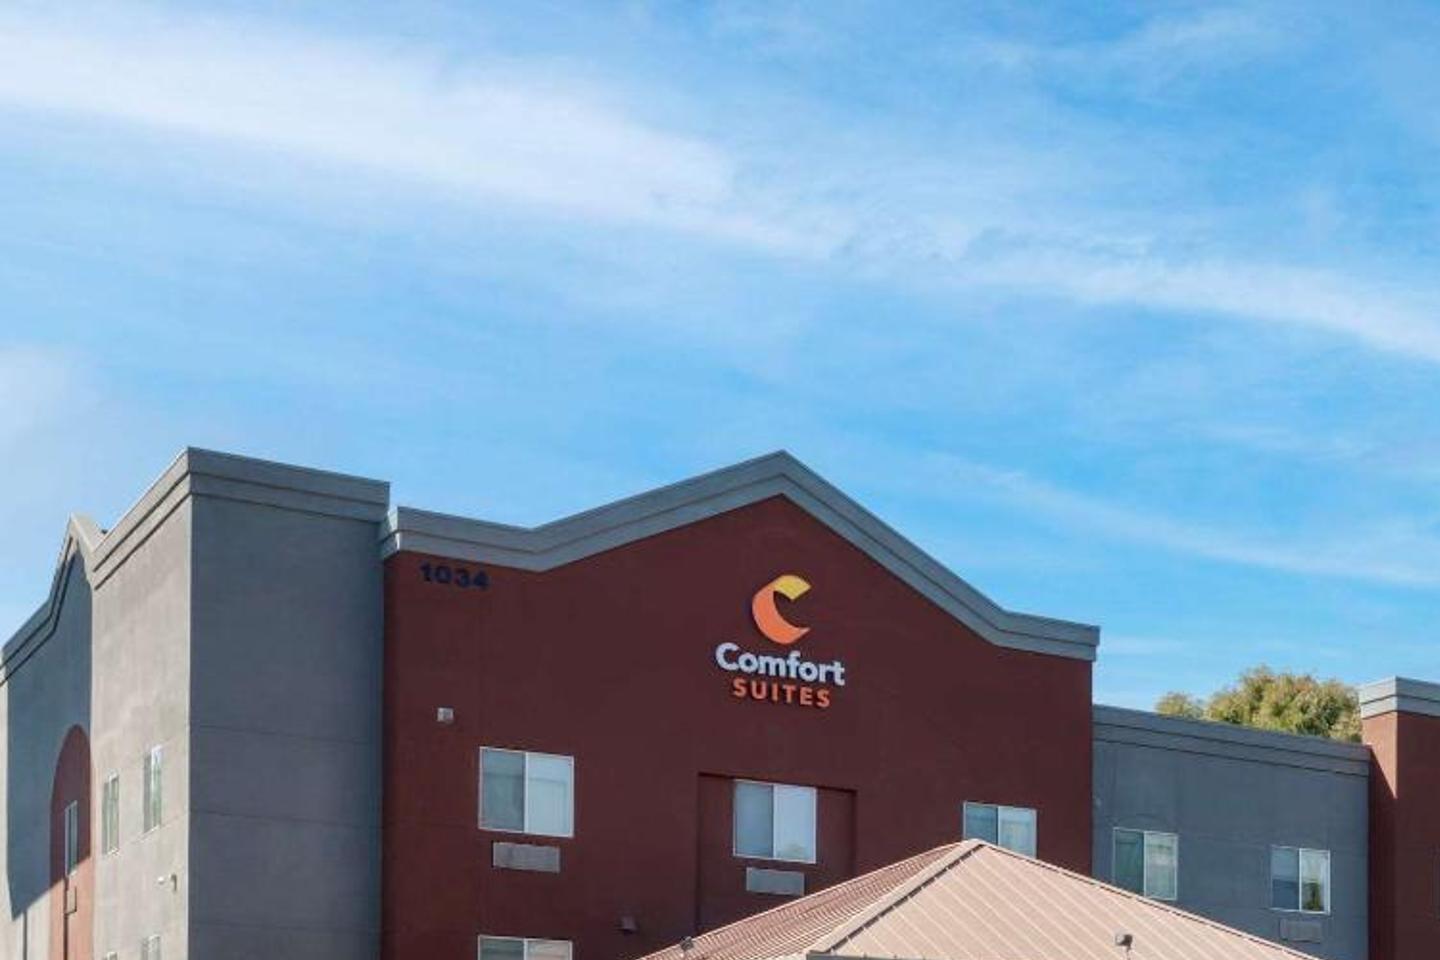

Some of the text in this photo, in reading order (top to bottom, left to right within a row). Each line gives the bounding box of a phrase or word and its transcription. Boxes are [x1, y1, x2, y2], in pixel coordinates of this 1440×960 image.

[420, 561, 490, 590] 1034
[715, 641, 846, 686] Comfort
[732, 677, 831, 707] SUITES
